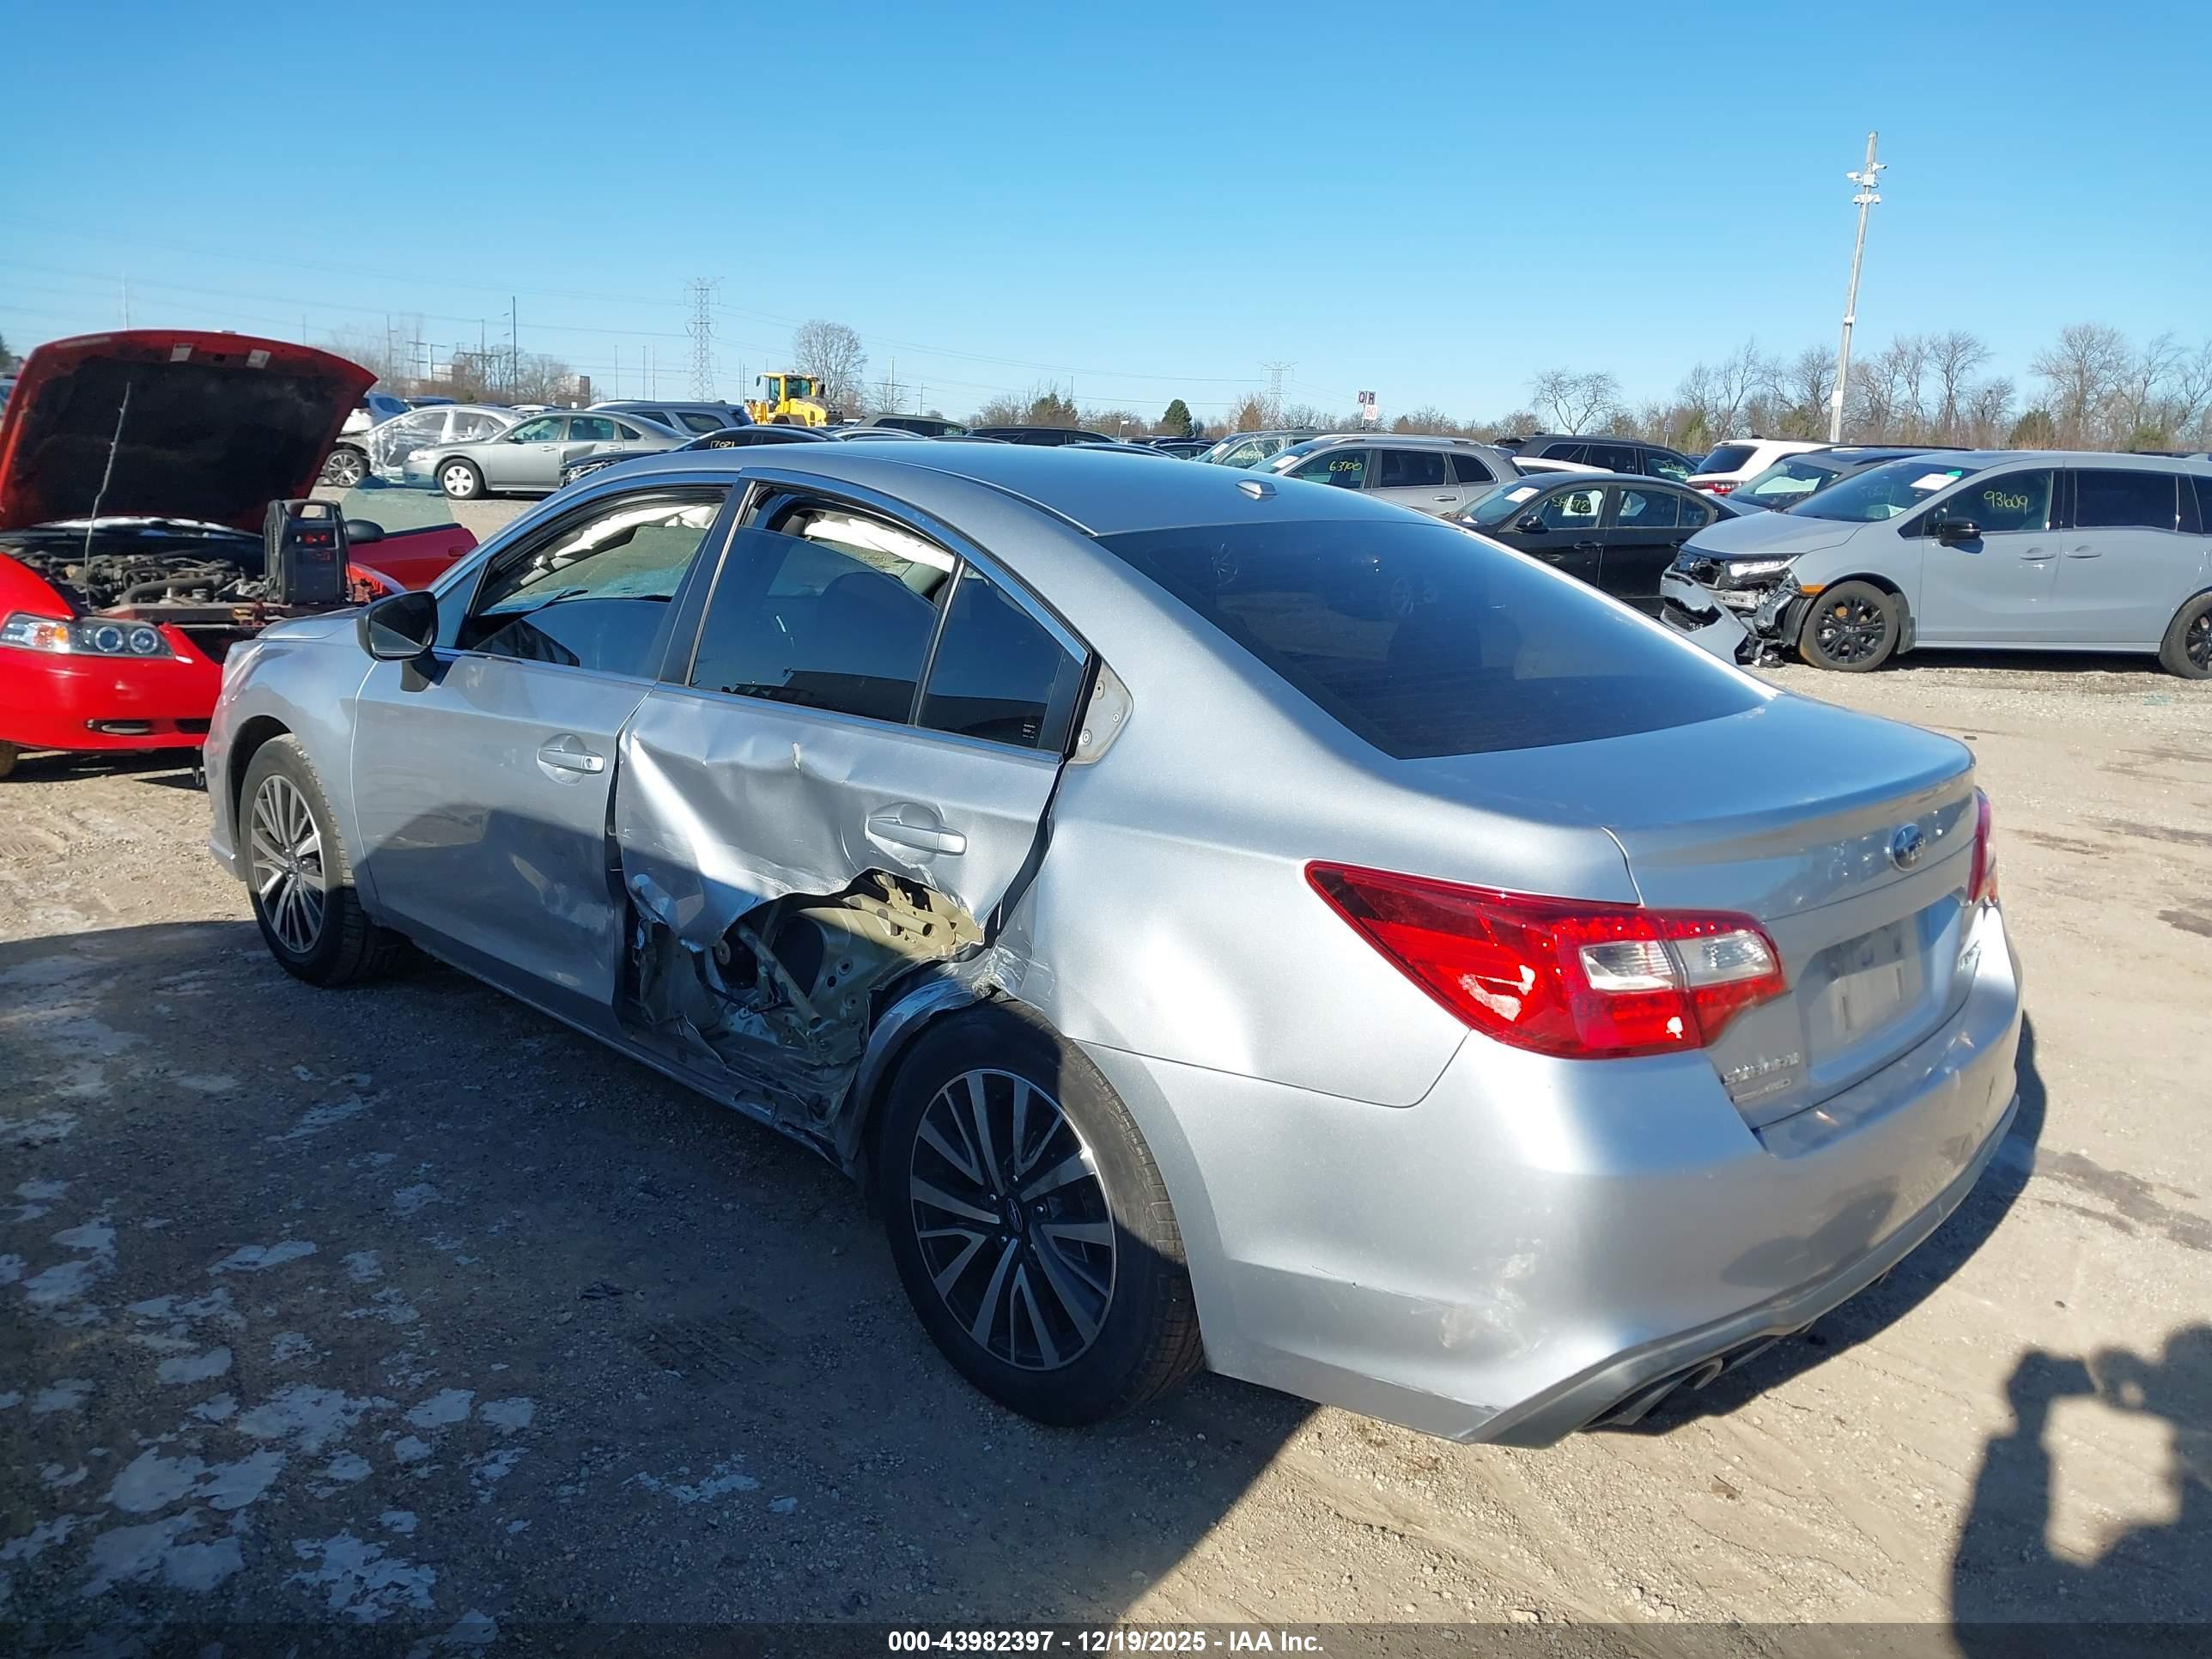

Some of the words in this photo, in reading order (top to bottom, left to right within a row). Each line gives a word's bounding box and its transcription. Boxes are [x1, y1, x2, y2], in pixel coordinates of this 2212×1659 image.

[1365, 406, 1376, 418] 80
[1328, 460, 1363, 472] 63700
[1984, 490, 2028, 515] 93609
